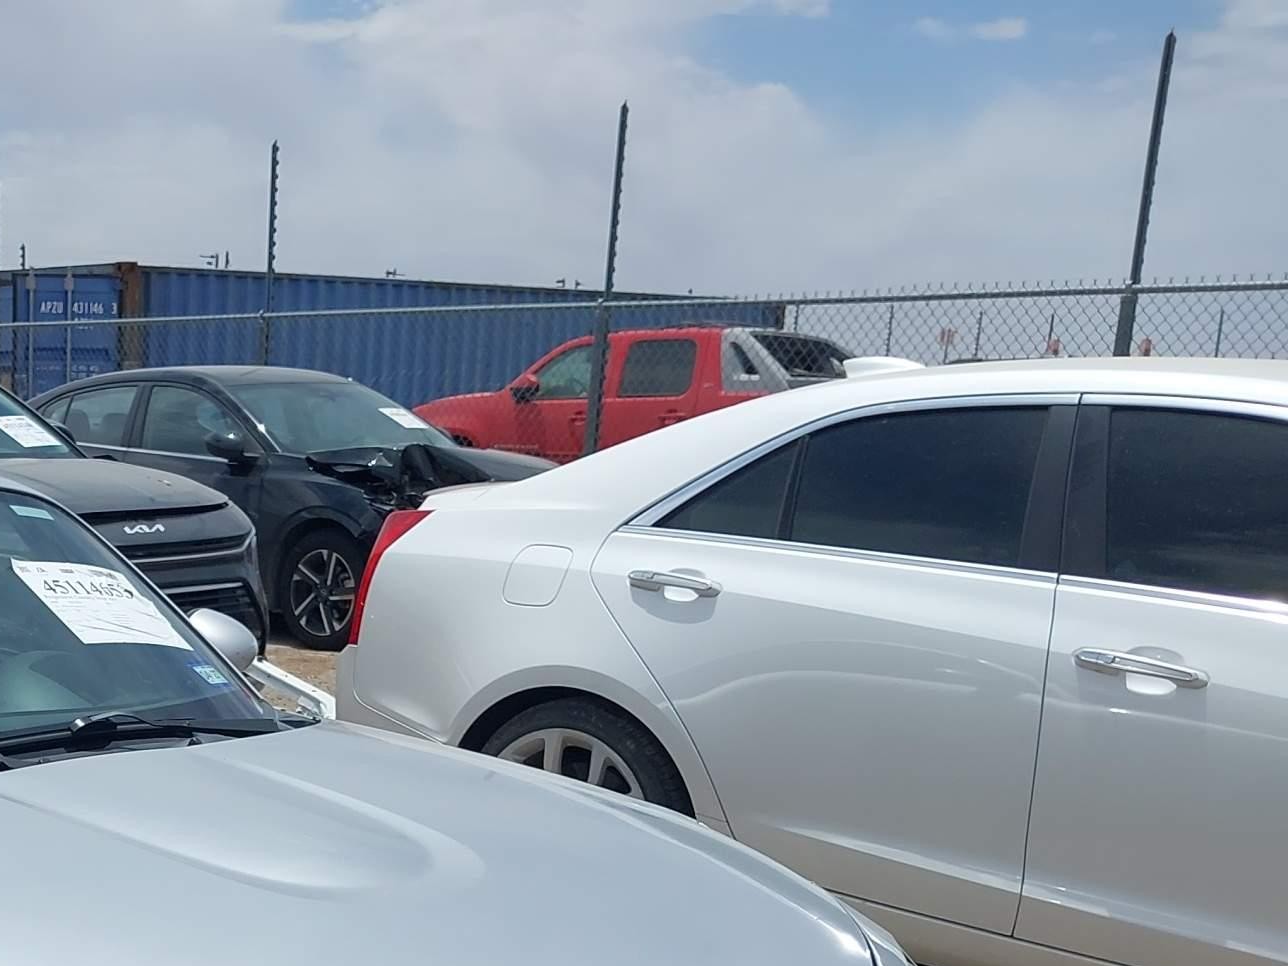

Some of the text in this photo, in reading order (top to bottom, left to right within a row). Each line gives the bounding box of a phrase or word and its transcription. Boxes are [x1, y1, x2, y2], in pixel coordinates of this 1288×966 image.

[40, 301, 118, 315] APZU 431146 3
[123, 524, 165, 534] KIA
[43, 579, 135, 600] 45114653
